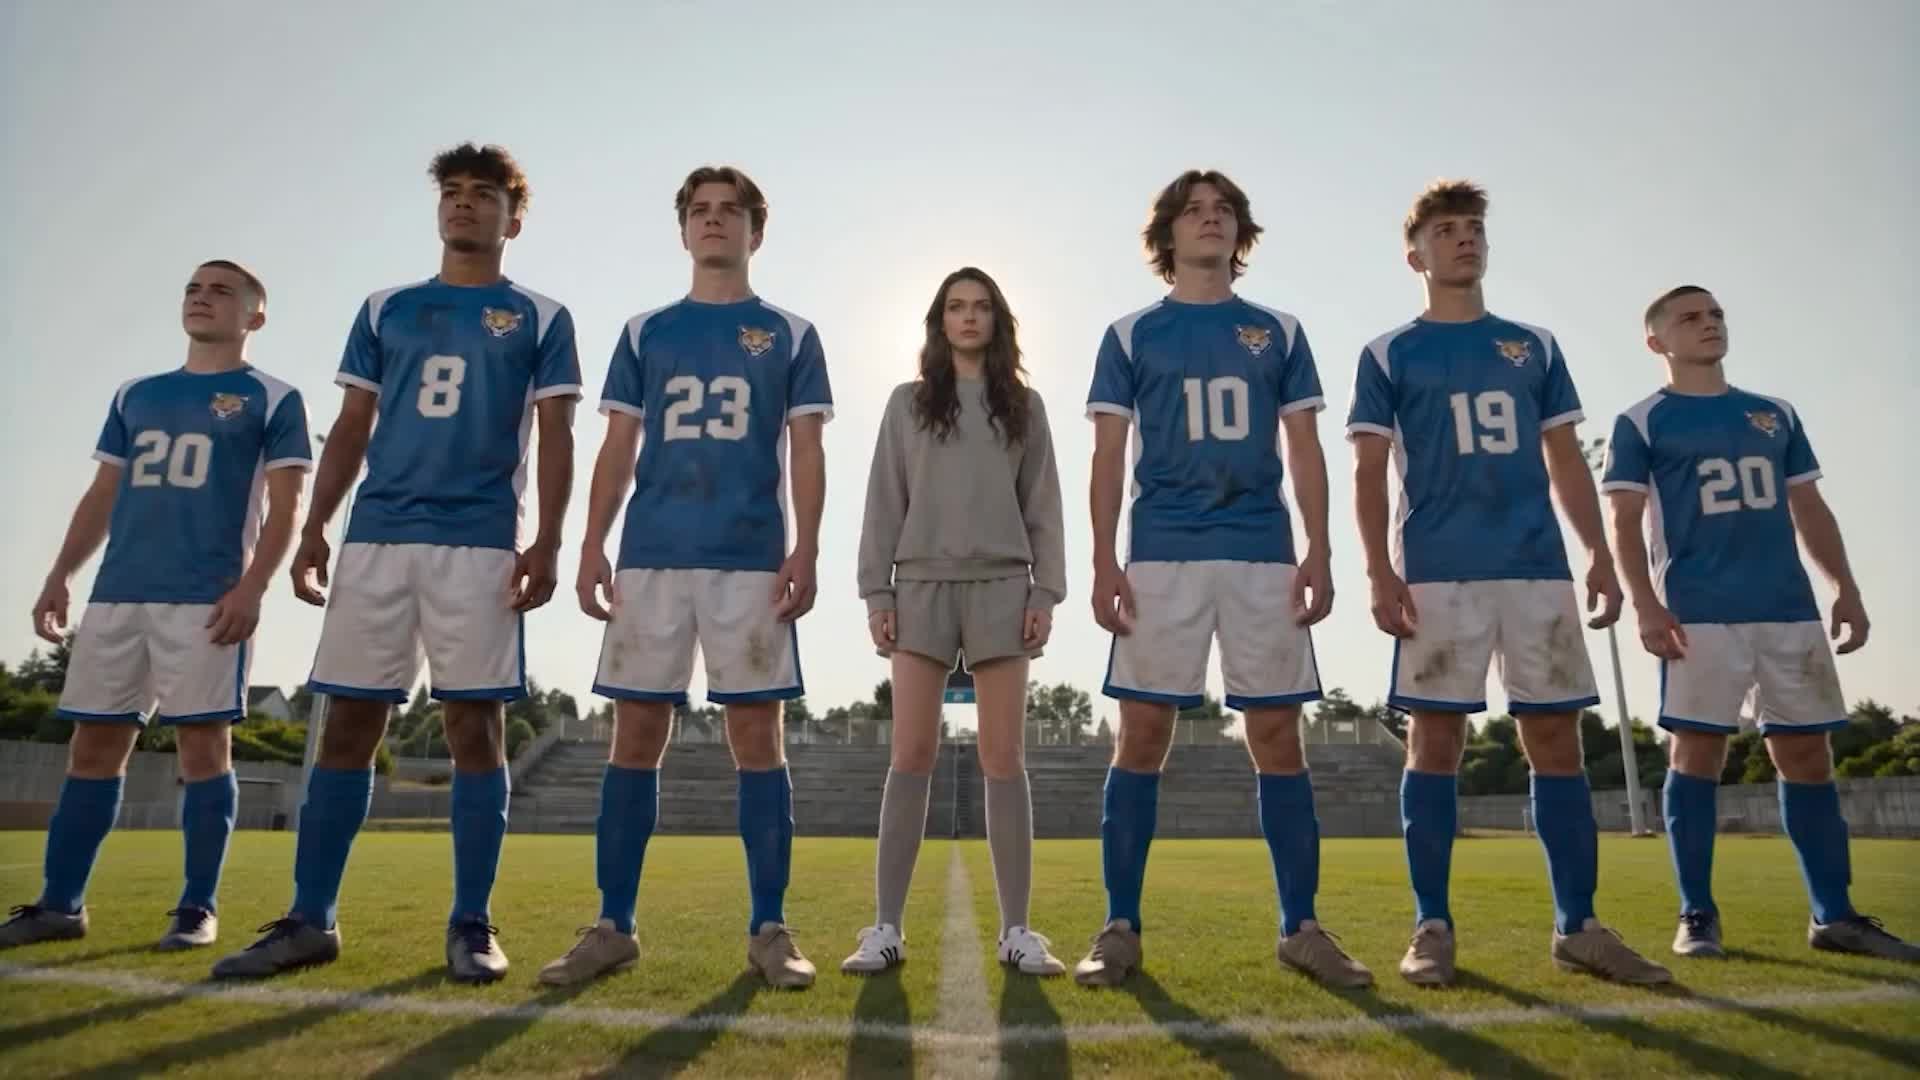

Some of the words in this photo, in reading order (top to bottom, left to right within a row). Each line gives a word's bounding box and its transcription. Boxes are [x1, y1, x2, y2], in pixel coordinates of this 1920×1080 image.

[417, 355, 467, 419] 8
[663, 375, 752, 441] 23
[1183, 376, 1250, 441] 10
[1450, 391, 1519, 454] 19
[131, 430, 213, 489] 20
[1698, 456, 1777, 514] 20
